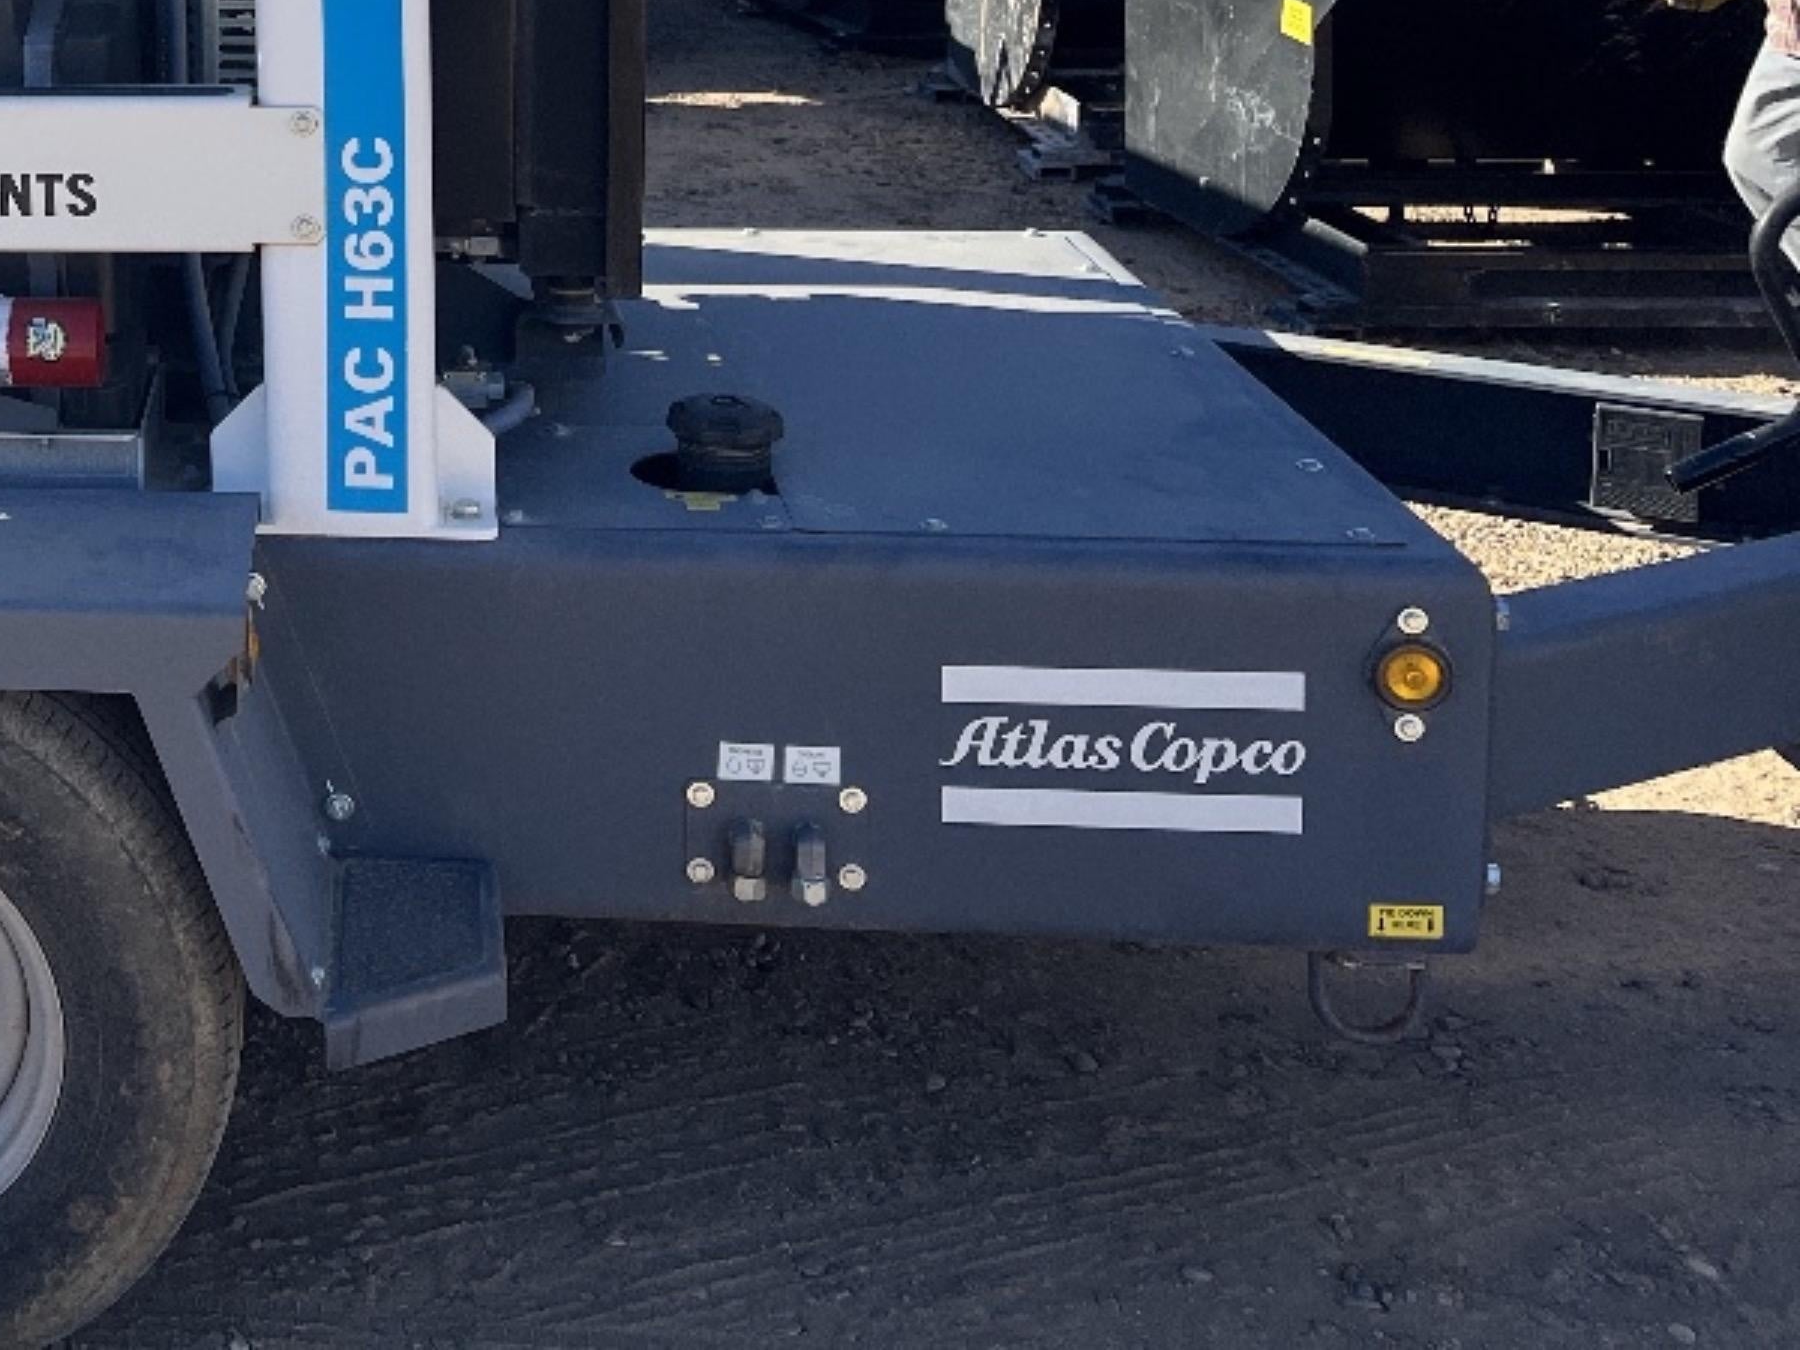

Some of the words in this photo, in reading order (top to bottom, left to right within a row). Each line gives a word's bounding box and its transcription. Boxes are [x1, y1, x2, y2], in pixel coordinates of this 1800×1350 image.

[341, 136, 395, 321] H63C
[343, 345, 394, 492] PAC
[940, 715, 1122, 771] Atlas
[1130, 720, 1307, 785] Copco
